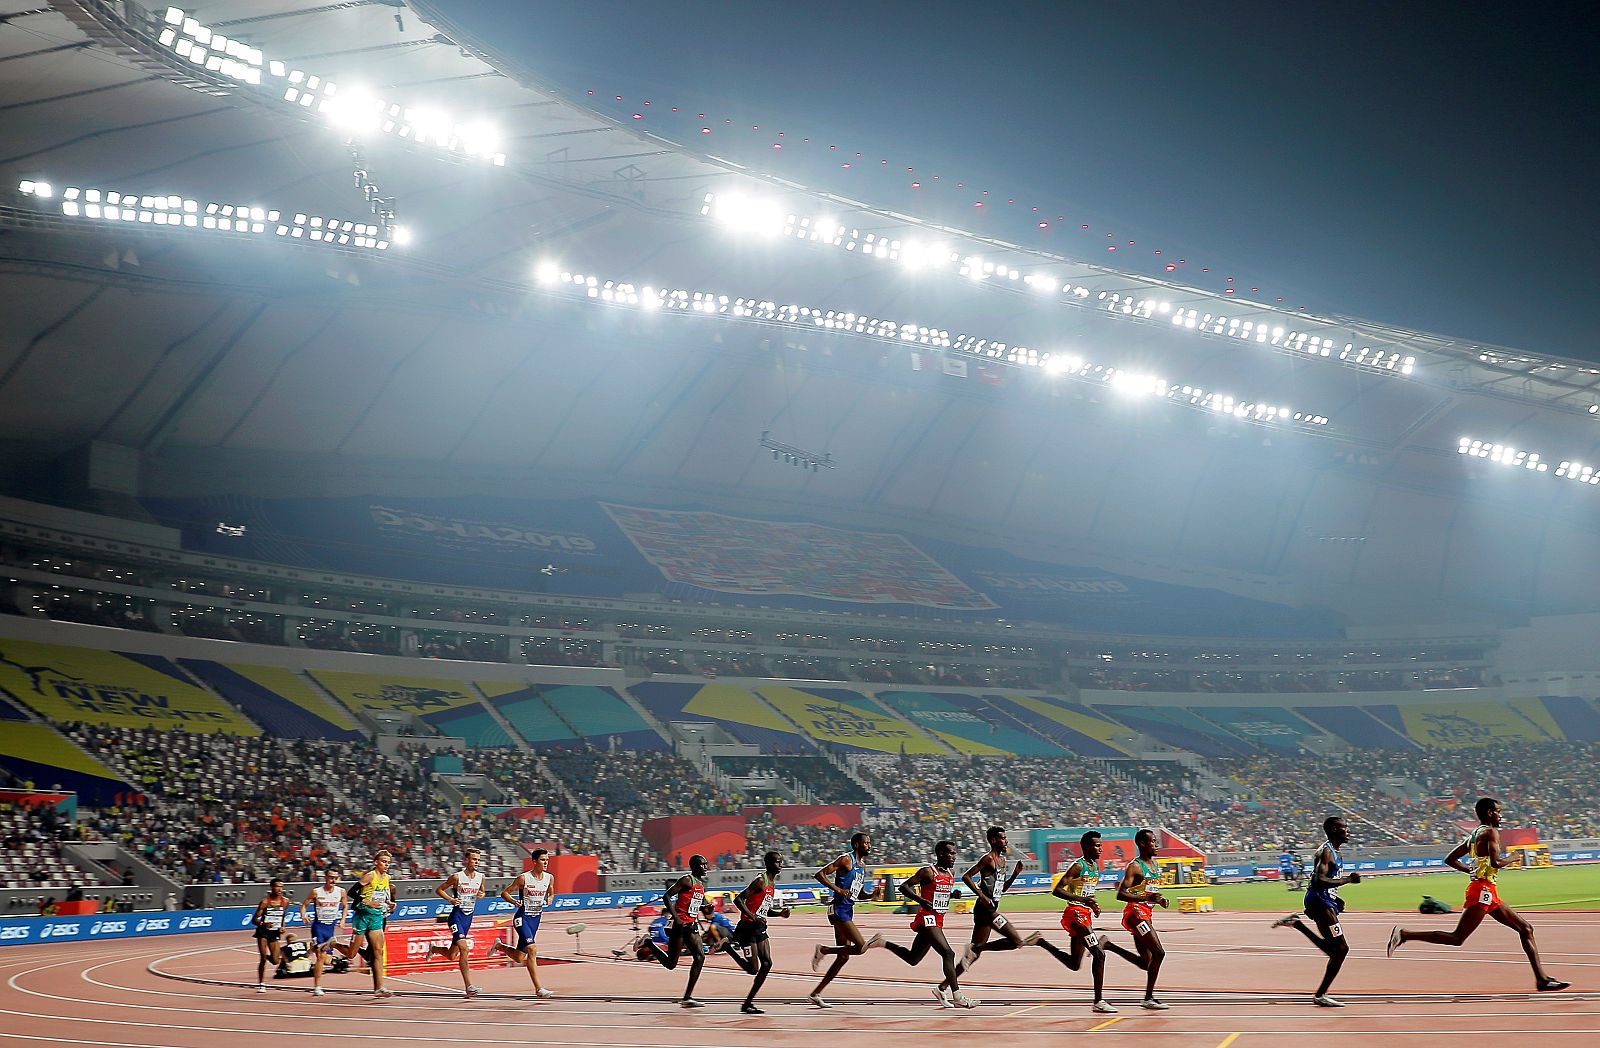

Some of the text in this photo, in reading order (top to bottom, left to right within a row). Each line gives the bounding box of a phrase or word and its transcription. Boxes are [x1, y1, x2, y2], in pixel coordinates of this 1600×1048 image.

[53, 685, 169, 708] NEW
[66, 700, 232, 723] HEIGHTS
[811, 720, 876, 731] NEW
[1425, 728, 1491, 737] NEW
[1483, 893, 1490, 902] 8
[925, 917, 935, 925] 12
[1140, 924, 1148, 933] 11
[1334, 926, 1340, 935] 9
[1087, 935, 1096, 944] 14
